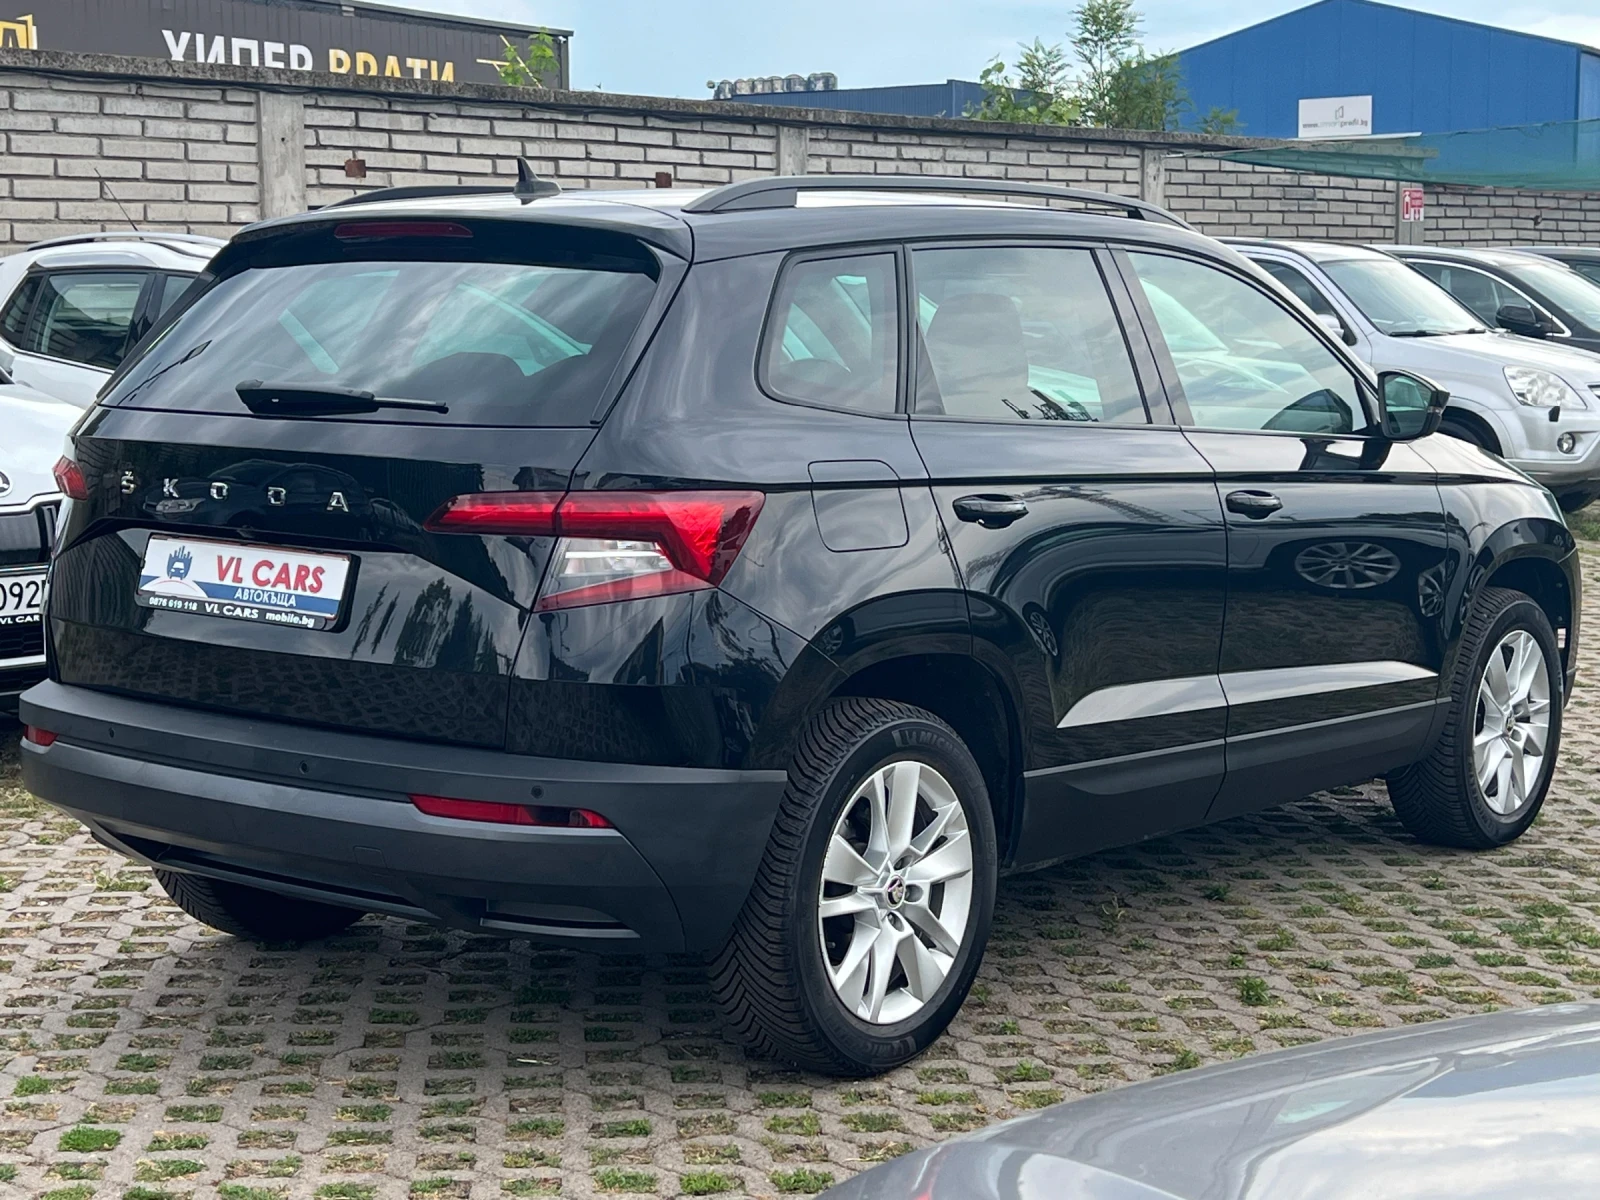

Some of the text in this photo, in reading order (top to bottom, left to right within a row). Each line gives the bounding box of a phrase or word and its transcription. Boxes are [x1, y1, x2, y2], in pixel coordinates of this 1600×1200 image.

[217, 555, 326, 594] VL CARS
[234, 588, 297, 608] АВТОКЪЩА
[15, 614, 40, 624] CAR
[168, 599, 182, 609] 619
[205, 603, 220, 614] VL
[223, 605, 259, 619] CARS
[265, 612, 315, 628] mobile.bg
